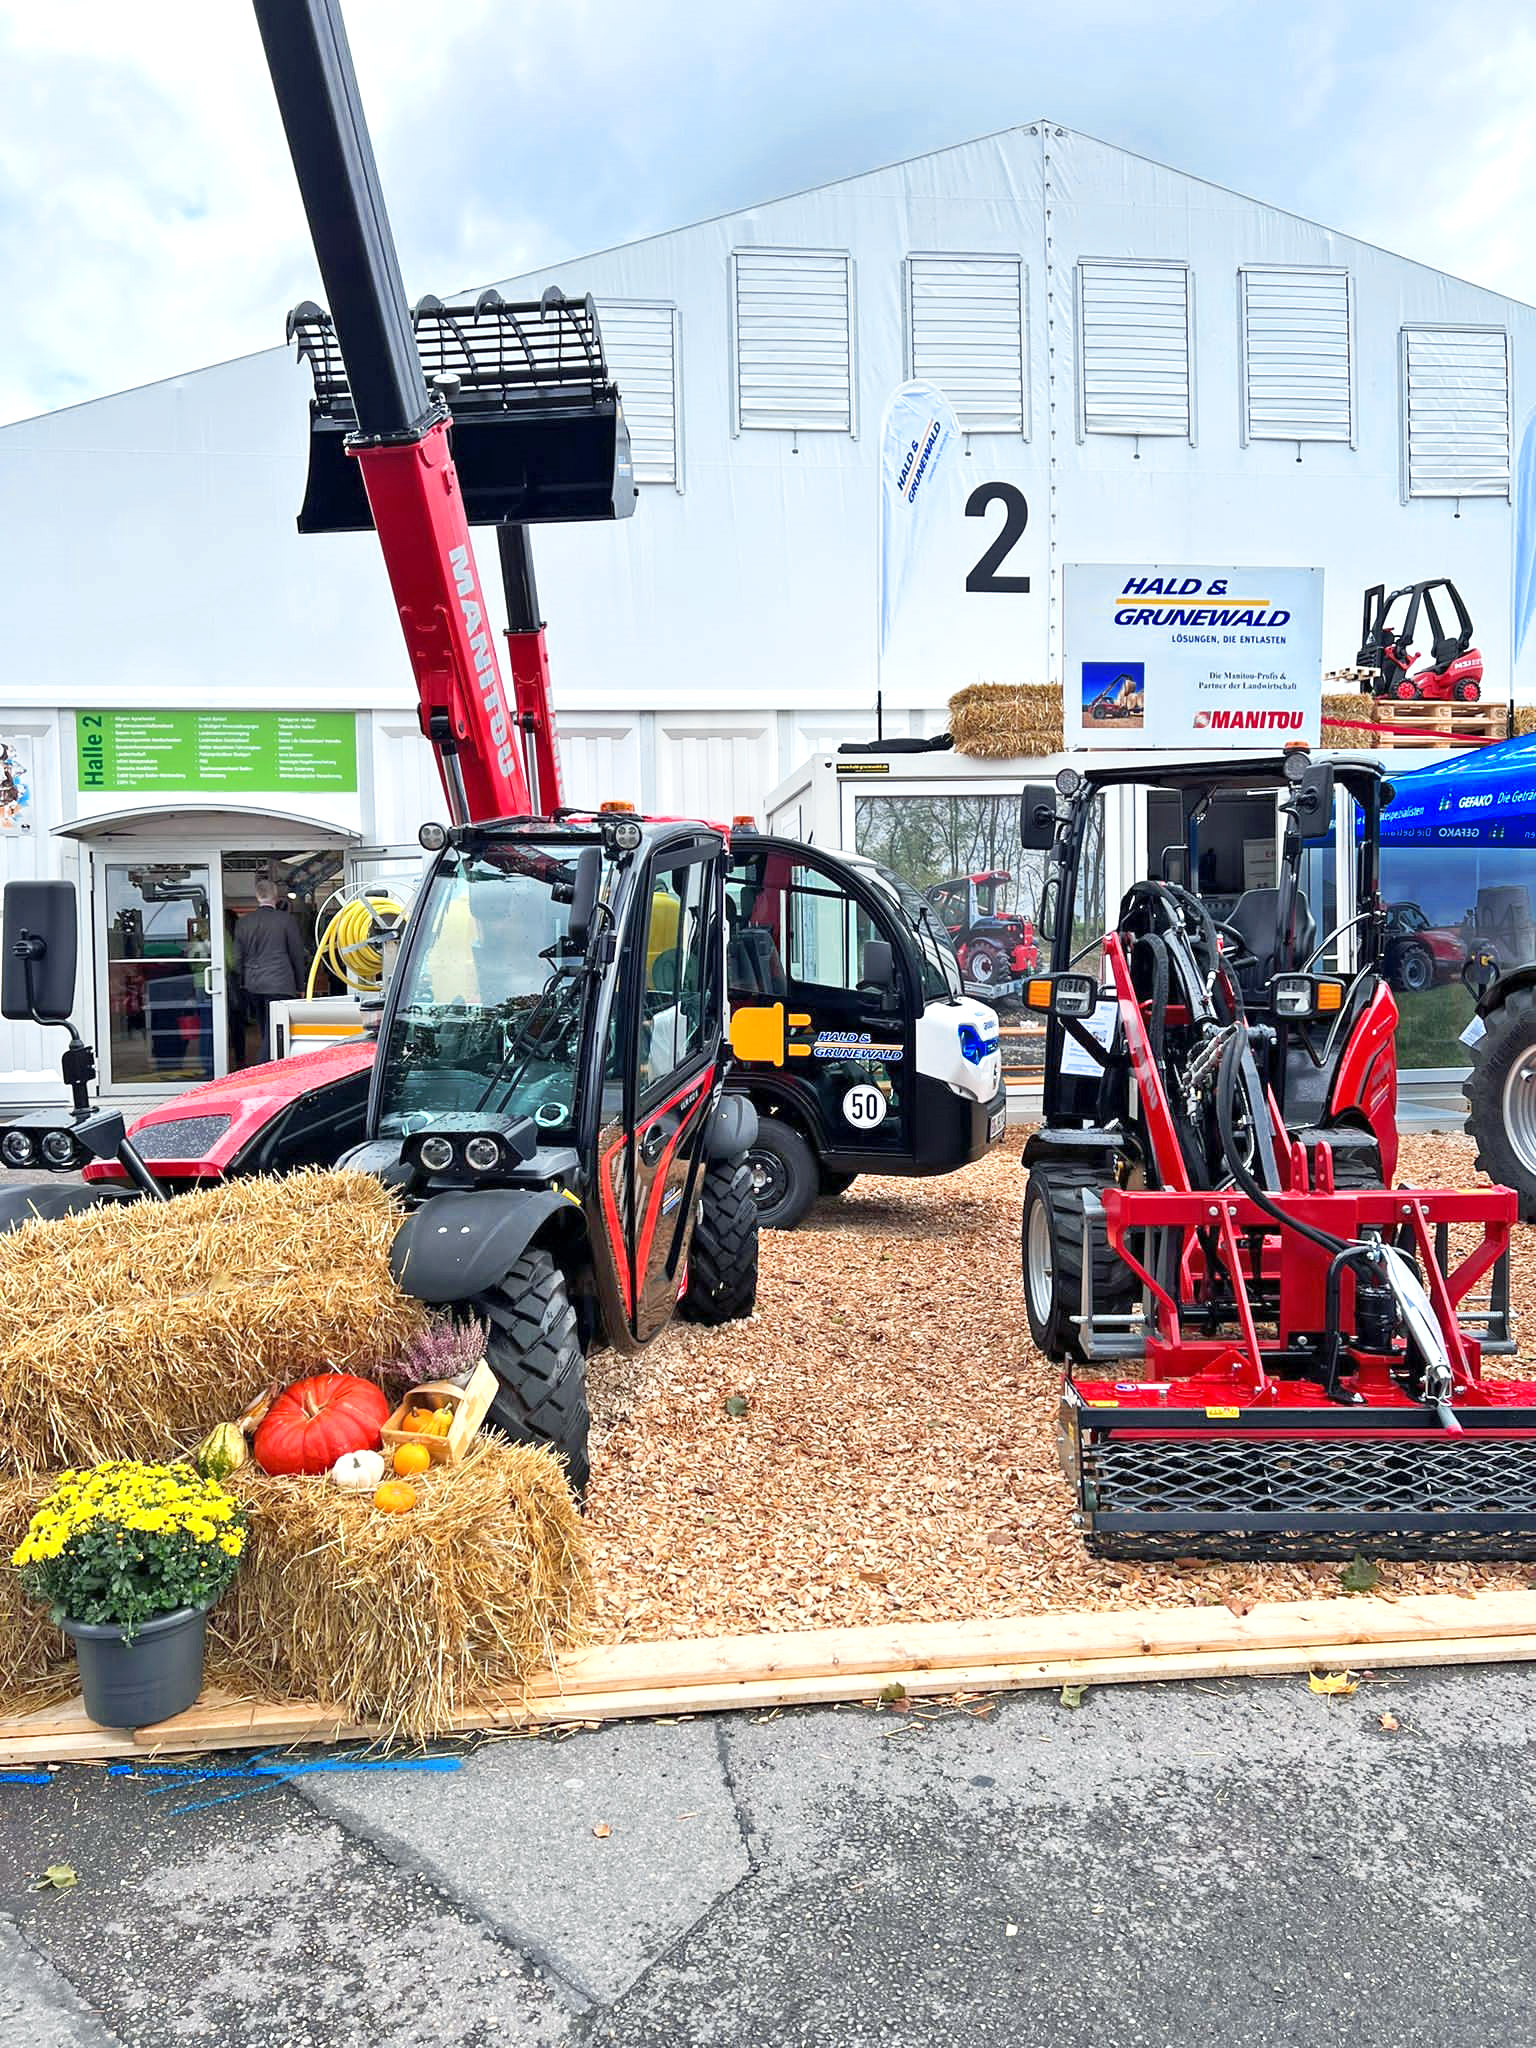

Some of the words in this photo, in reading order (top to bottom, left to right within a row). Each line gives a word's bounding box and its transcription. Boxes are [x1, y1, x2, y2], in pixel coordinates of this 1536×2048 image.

[897, 451, 915, 491] HALD
[908, 421, 941, 504] GRUNEWALD
[964, 481, 1030, 593] 2
[1122, 577, 1202, 596] HALD
[1207, 578, 1229, 596] &
[1114, 608, 1291, 627] GRUNEWALD
[1171, 633, 1220, 645] LÖSUNGEN,
[1223, 635, 1237, 644] DIE
[1239, 635, 1287, 645] ENTLASTEN
[448, 543, 515, 778] MANITOU
[1208, 671, 1223, 680] Die
[1224, 671, 1279, 681] Manitou-Profis
[1279, 672, 1287, 680] &
[1198, 681, 1226, 690] Partner
[1228, 681, 1241, 690] der
[1242, 681, 1298, 691] Landwirtschaft
[83, 715, 103, 728] 2
[1211, 711, 1304, 729] MANITOU
[82, 734, 104, 786] Halle
[1458, 793, 1493, 809] GEFAKO
[1497, 791, 1511, 805] Die
[817, 1031, 858, 1042] HALD
[859, 1032, 872, 1043] &
[813, 1047, 904, 1061] GRUNEWALD
[851, 1093, 878, 1121] 50
